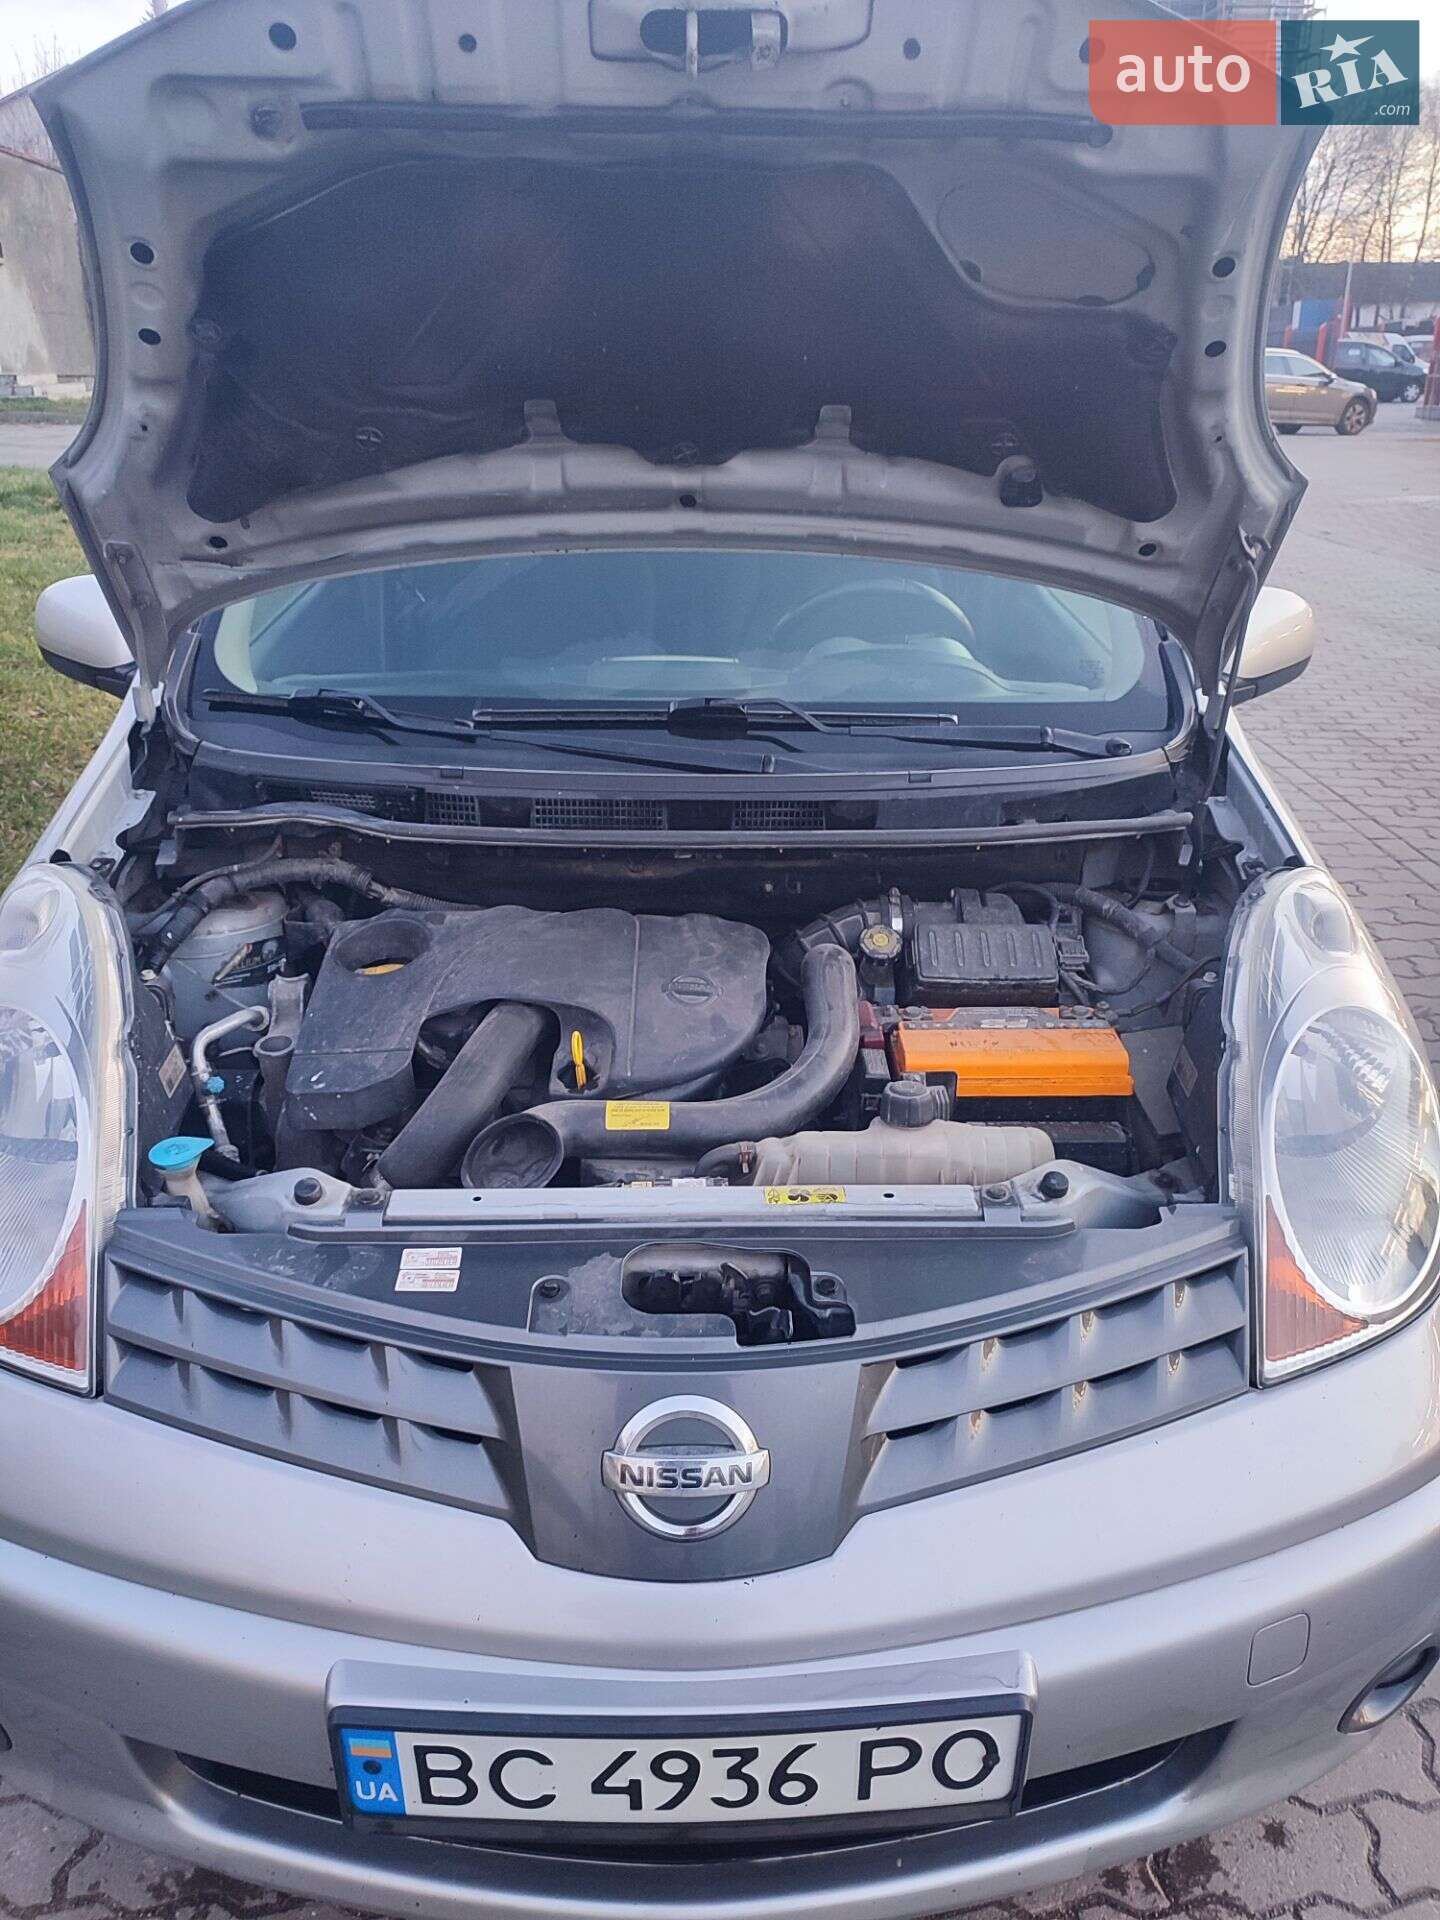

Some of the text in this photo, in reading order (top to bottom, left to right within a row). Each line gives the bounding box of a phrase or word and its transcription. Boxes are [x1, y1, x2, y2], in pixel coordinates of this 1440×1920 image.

[620, 1462, 753, 1489] NISSAN
[411, 1729, 1002, 1812] BC 4936 PO
[355, 1780, 399, 1802] UA
